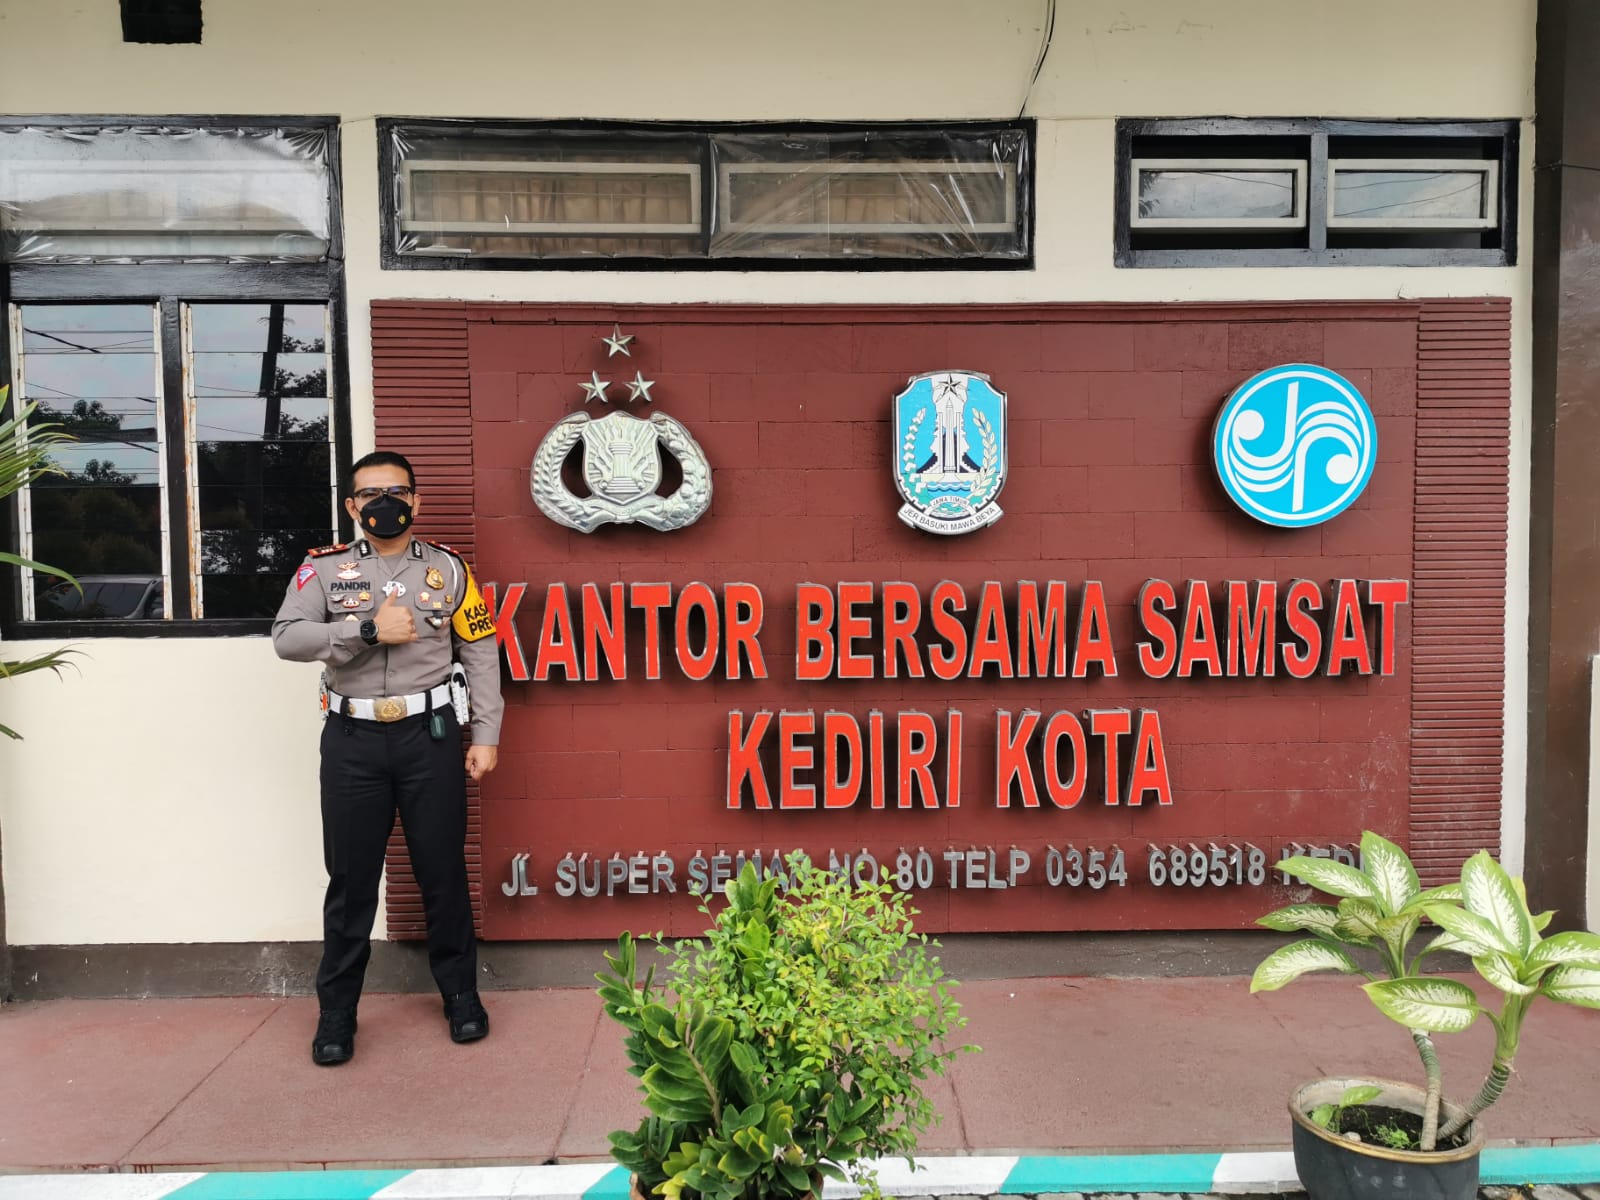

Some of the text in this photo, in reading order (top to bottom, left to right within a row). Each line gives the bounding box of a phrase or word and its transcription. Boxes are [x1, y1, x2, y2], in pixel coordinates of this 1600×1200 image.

[903, 507, 996, 531] JER BASUKI MAWA BEYA
[330, 581, 371, 592] PANDRI
[482, 578, 1410, 681] KANTOR BERSAMA SAMSAT
[726, 708, 1174, 810] KEDIRI KOTA
[501, 857, 538, 897] JL
[554, 856, 677, 897] SUPER
[896, 852, 934, 891] 80
[943, 849, 1031, 889] TELP
[1046, 848, 1129, 889] 0354
[1149, 848, 1266, 888] 689518
